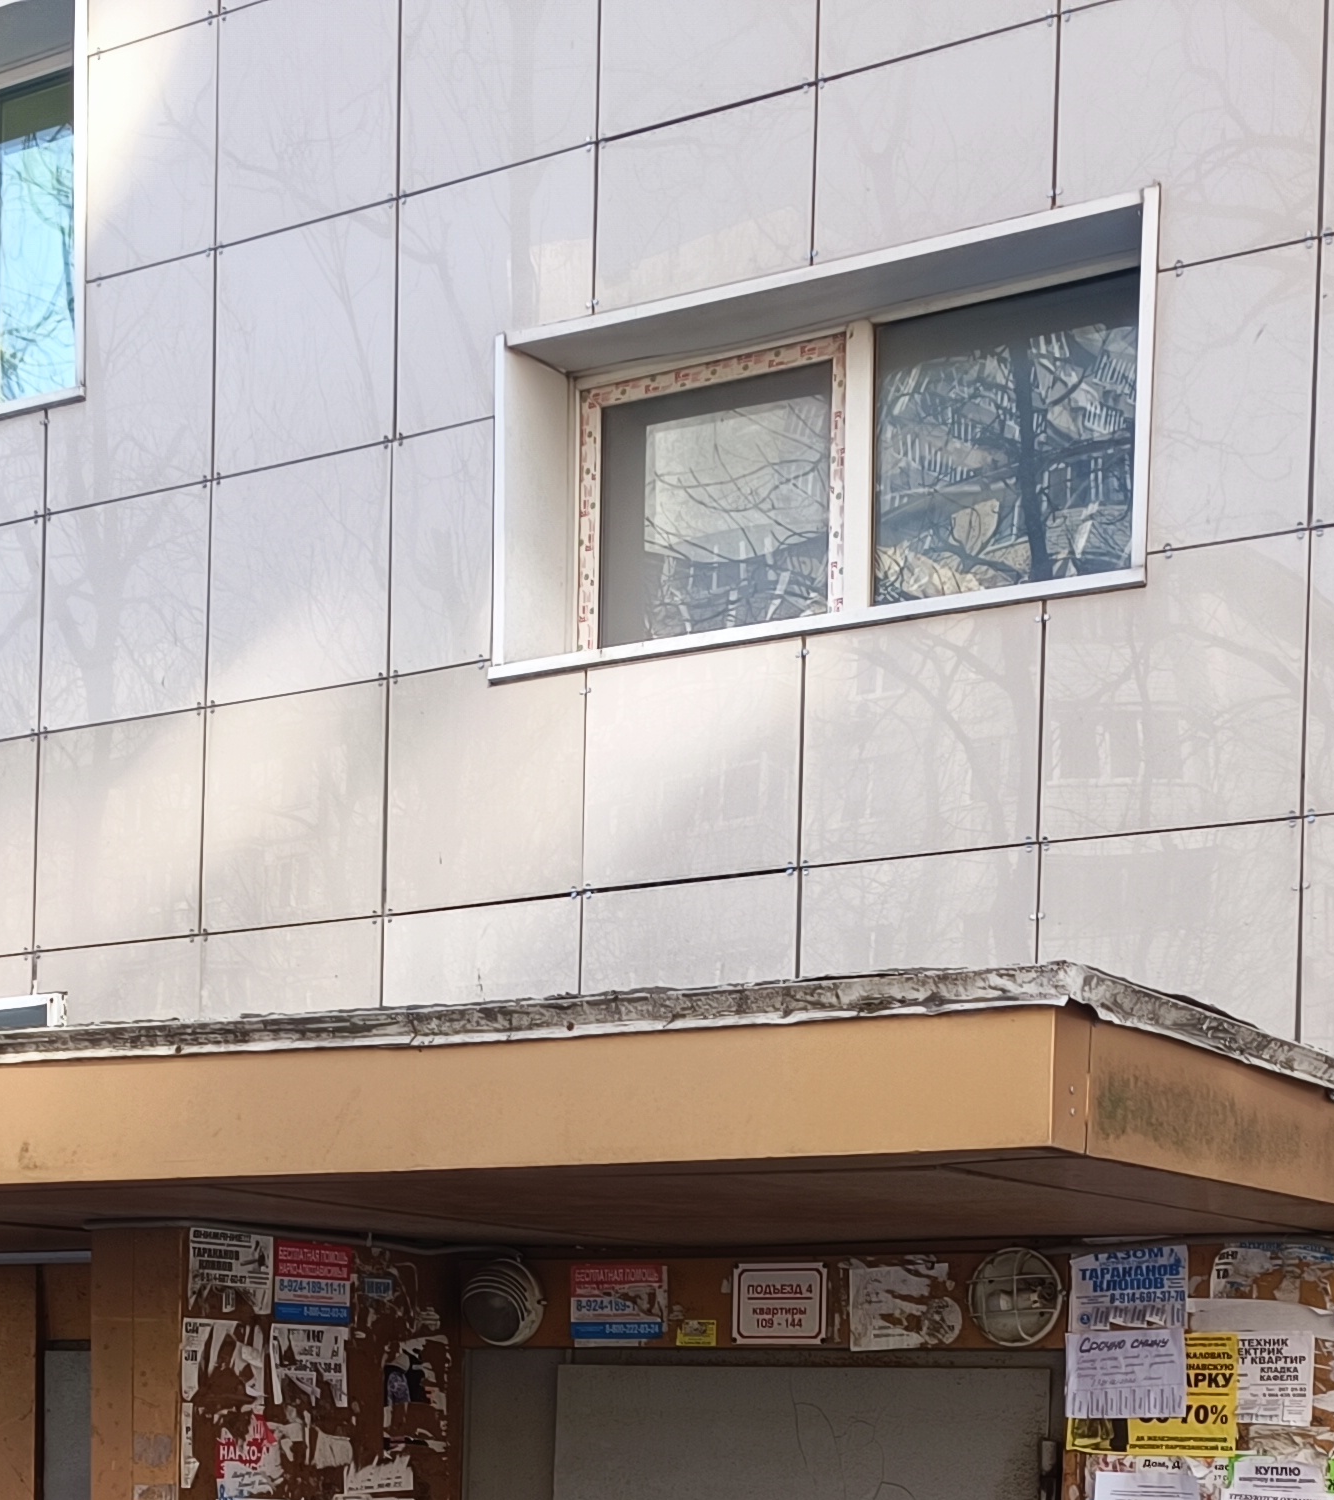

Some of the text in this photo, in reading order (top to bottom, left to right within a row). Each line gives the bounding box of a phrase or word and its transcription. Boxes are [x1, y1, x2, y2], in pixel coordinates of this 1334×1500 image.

[1079, 1263, 1181, 1281] ТАРАКАНОВ
[747, 1284, 813, 1295] ПОДЪЕЗД 4
[1092, 1277, 1165, 1293] КЛОПОВ
[752, 1306, 807, 1321] квартиры
[755, 1318, 774, 1328] 109
[784, 1317, 803, 1329] 144
[1079, 1337, 1126, 1354] Срочно
[1251, 1355, 1307, 1365] КВАРТИР
[1260, 1366, 1299, 1374] КЛАДКА
[1259, 1374, 1299, 1382] КАФЕЛЯ
[1255, 1466, 1301, 1476] КУПЛЮ
